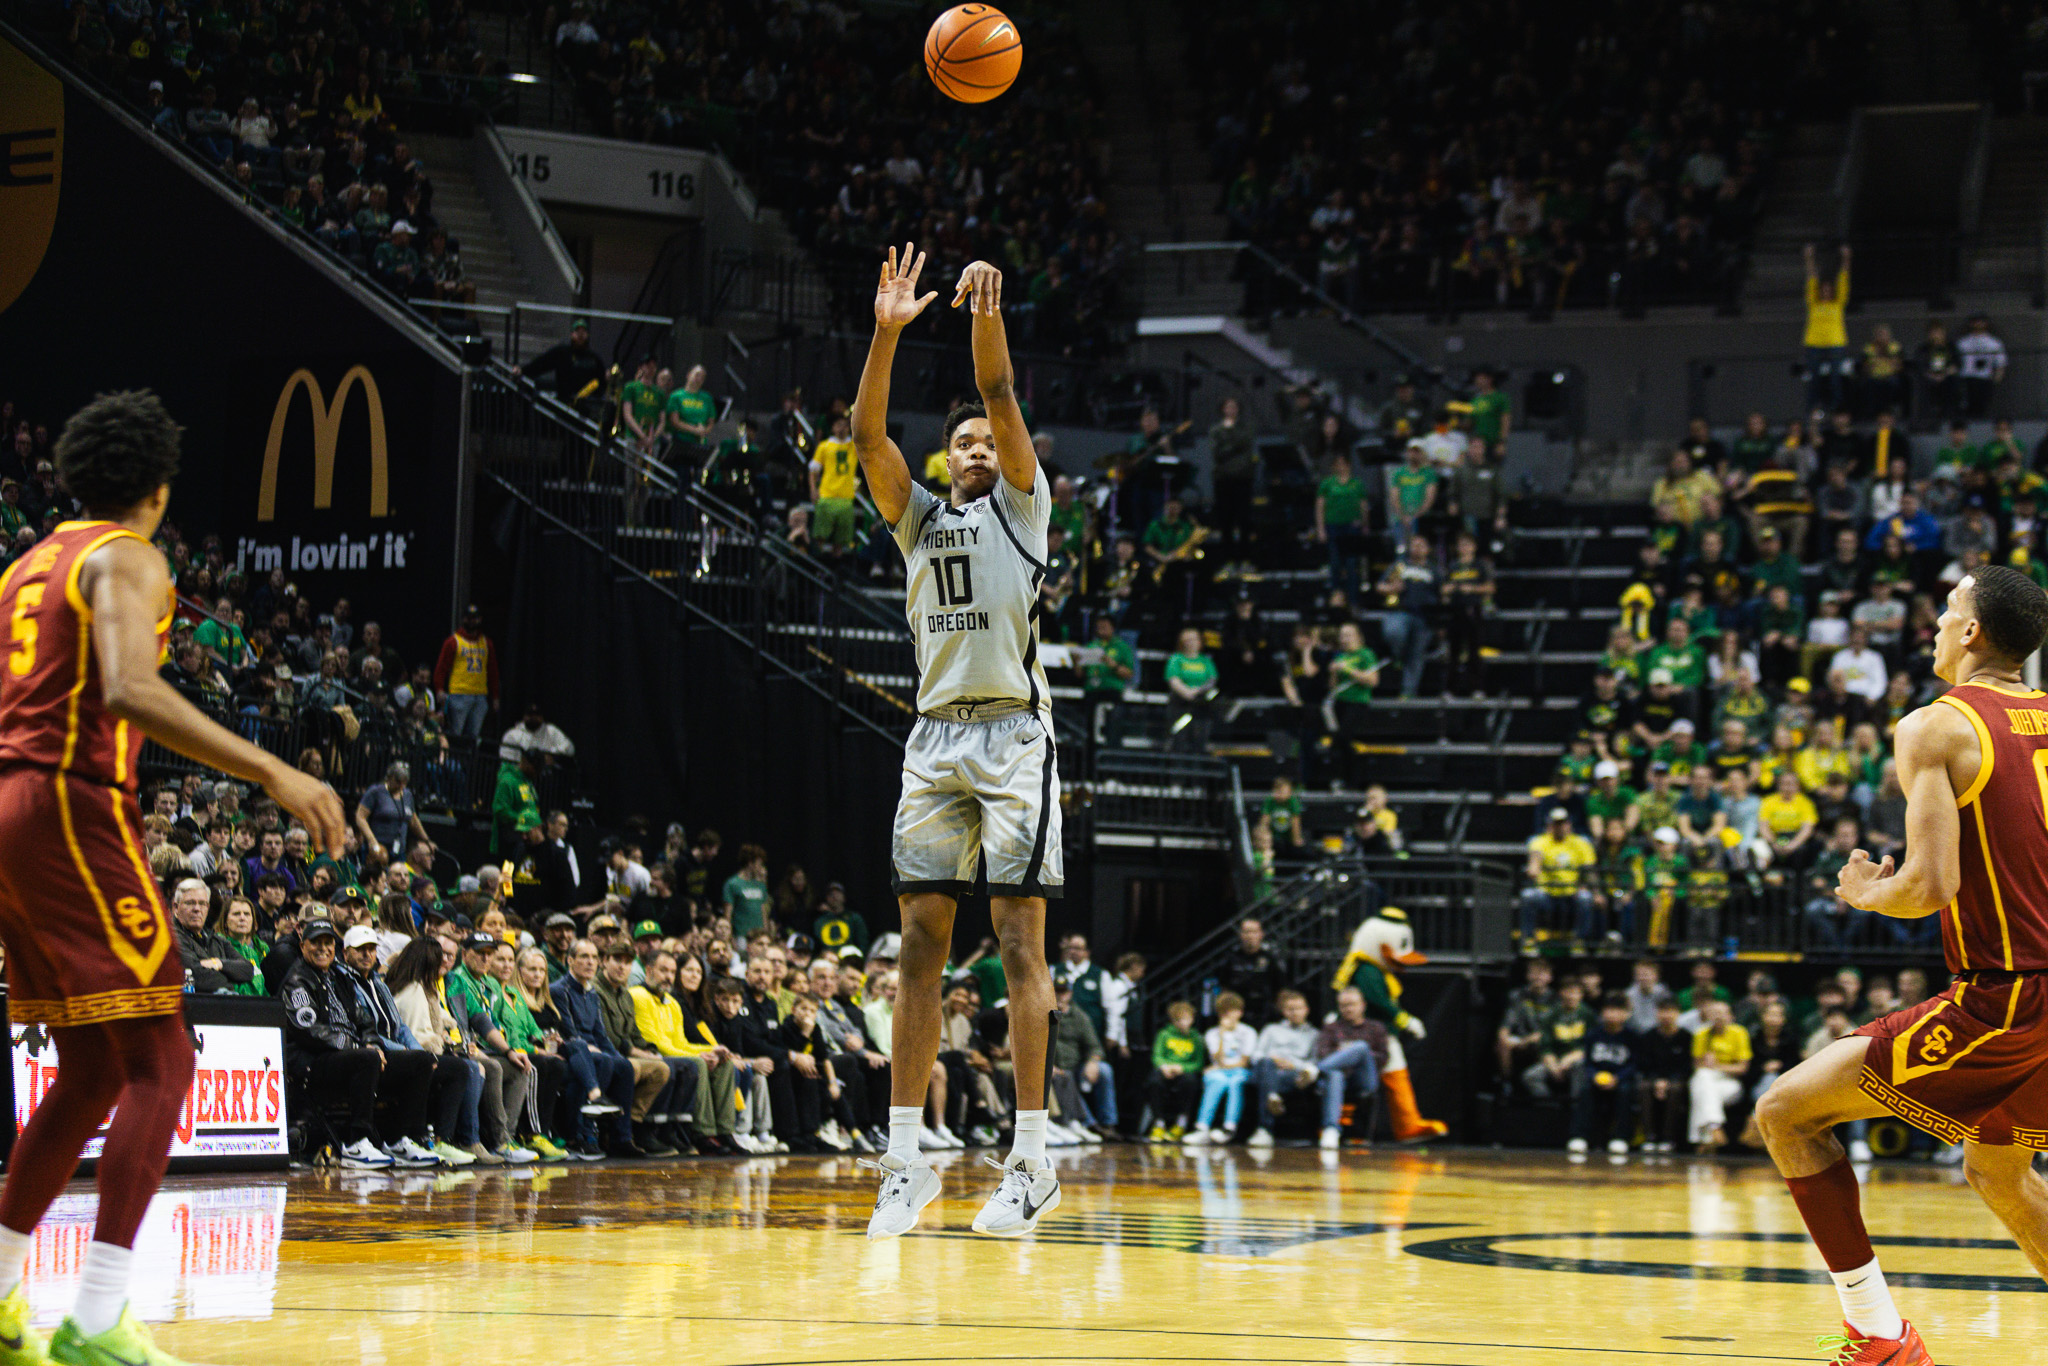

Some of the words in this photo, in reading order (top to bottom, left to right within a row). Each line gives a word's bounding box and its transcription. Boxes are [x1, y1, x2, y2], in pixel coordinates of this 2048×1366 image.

[648, 170, 695, 200] 116
[290, 531, 379, 571] lovin'
[383, 531, 407, 569] it
[929, 554, 974, 607] 10
[8, 582, 47, 676] 5
[927, 611, 990, 634] OREGON
[820, 920, 850, 946] O
